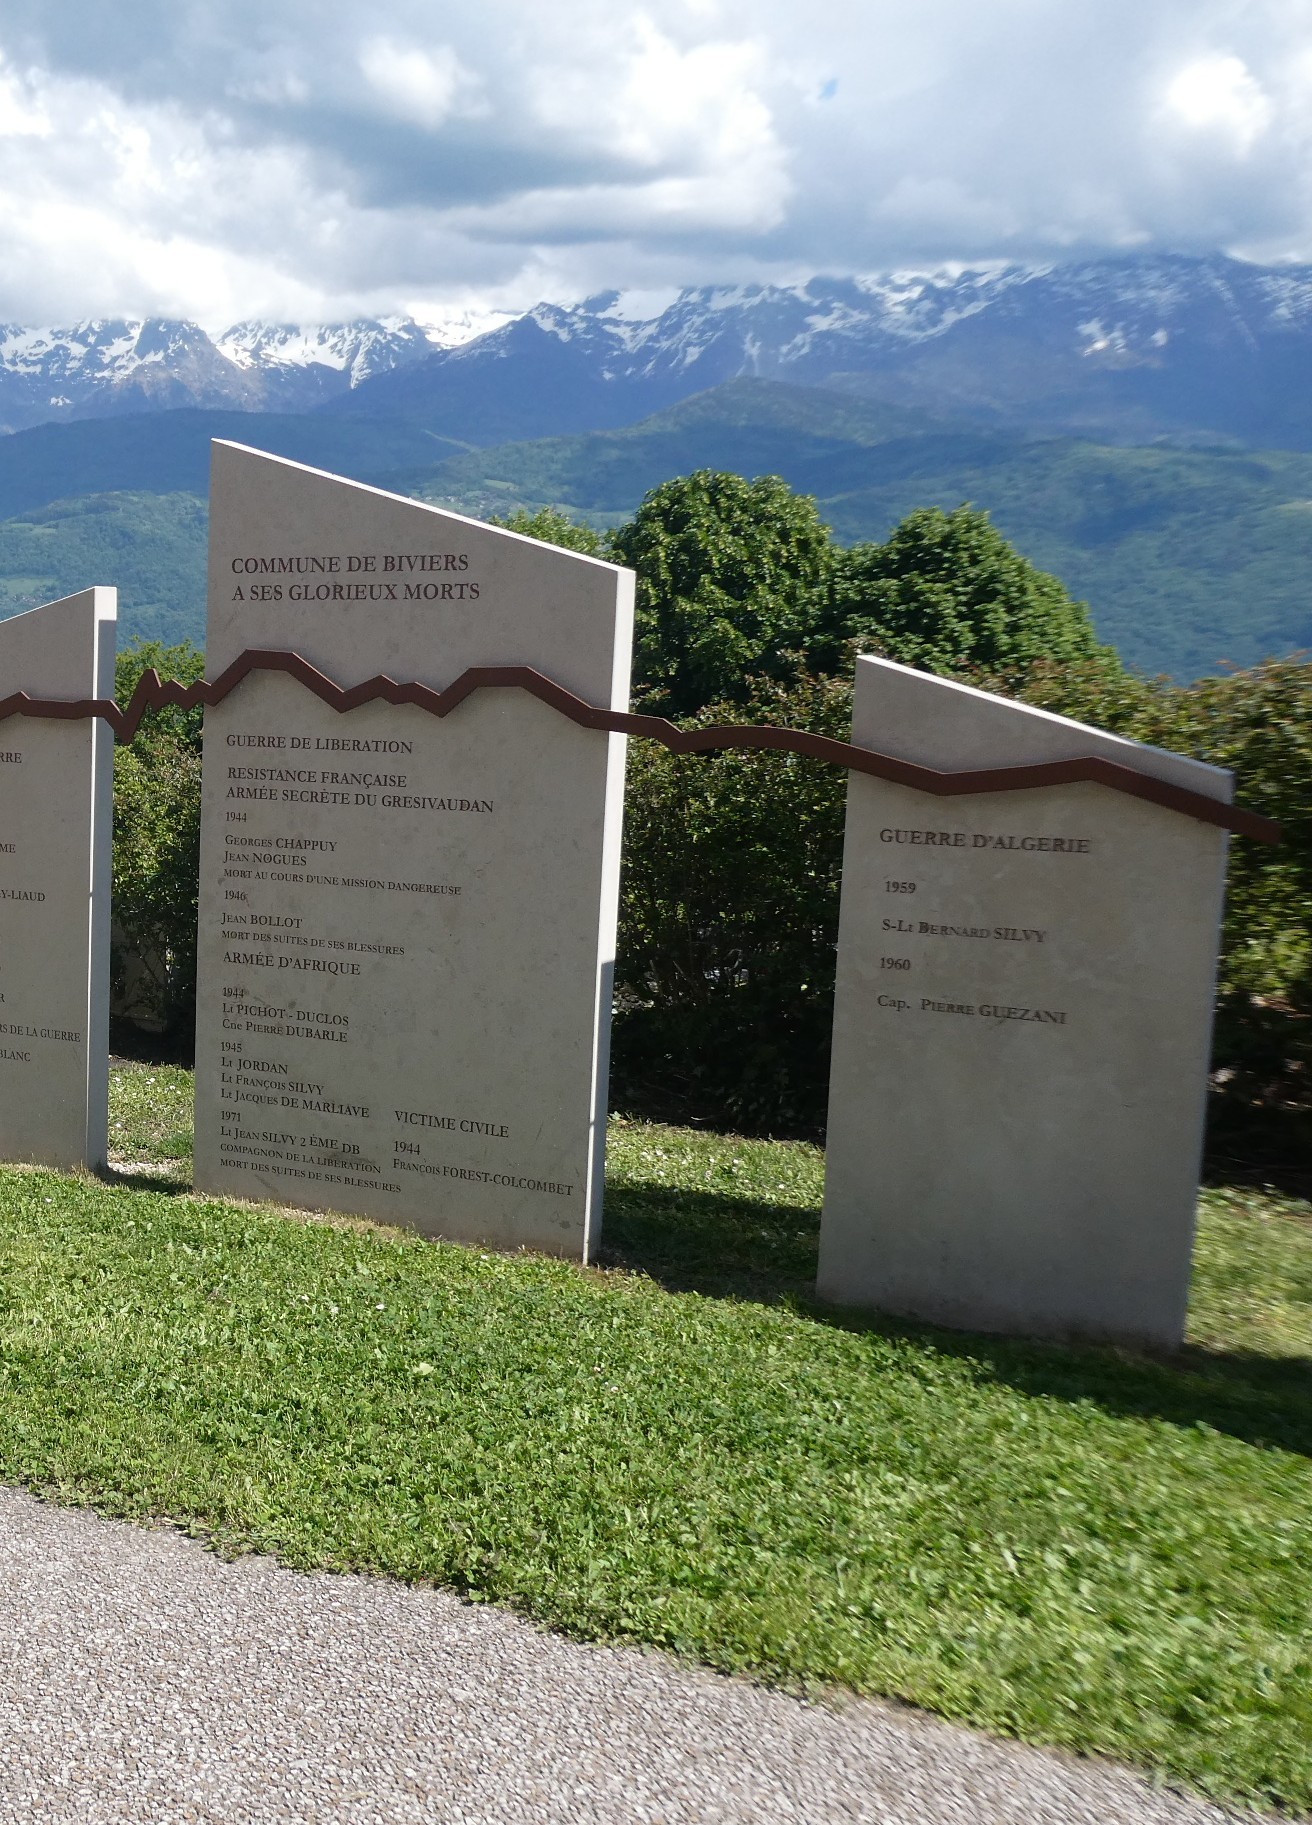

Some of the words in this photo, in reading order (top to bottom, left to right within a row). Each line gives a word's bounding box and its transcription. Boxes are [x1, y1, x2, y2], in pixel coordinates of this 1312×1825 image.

[232, 557, 340, 574] COMMUNE
[346, 556, 376, 572] DE
[382, 554, 469, 572] BIVIERS
[232, 586, 244, 601] A
[250, 585, 283, 601] SES
[288, 583, 398, 601] GLORIEUX
[404, 583, 480, 600] MORTS
[226, 734, 286, 749] GUERRE
[290, 737, 311, 750] DE
[315, 738, 414, 754] LIBERATION
[228, 767, 317, 783] RESISTANCE
[321, 772, 407, 789] FRANÇAISE
[226, 785, 278, 800] ARMÉE
[355, 793, 377, 806] DU
[382, 795, 494, 813] GRESIVAUDAN
[225, 811, 247, 823] 1944
[276, 838, 338, 852] CHAPPUY
[879, 828, 966, 848] GUERRE
[252, 852, 307, 866] NOGUES
[224, 869, 252, 878] MORT
[254, 871, 268, 880] AU
[270, 872, 304, 882] COURS
[306, 874, 339, 886] D'UNE
[342, 877, 385, 889] MISSION
[388, 881, 462, 896] DANGEREUSE
[885, 880, 916, 894] 1959
[224, 890, 247, 901] 1946
[250, 915, 303, 928] BOLLOT
[222, 930, 250, 940] MORT
[253, 933, 271, 942] DES
[273, 935, 308, 945] SUITES
[310, 938, 325, 948] DE
[327, 940, 345, 950] SES
[347, 942, 405, 956] BLESSURES
[993, 927, 1047, 943] SILVY
[223, 951, 274, 967] ARMÉE
[279, 956, 361, 976] D'AFRIQUE
[880, 957, 911, 971] 1960
[223, 987, 244, 999] 1944
[222, 1003, 234, 1014] Lt
[237, 1004, 286, 1019] PICHOT
[296, 1010, 349, 1026] DUCLOS
[877, 994, 911, 1012] Cap.
[979, 1004, 1068, 1025] GUEZANI
[10, 1025, 24, 1036] DE
[26, 1027, 38, 1037] LA
[40, 1028, 81, 1042] GUERRE
[222, 1018, 243, 1030] Cne
[286, 1025, 348, 1042] DUBARLE
[221, 1041, 242, 1052] 1945
[221, 1057, 232, 1068] Lt
[237, 1059, 288, 1074] JORDAN
[221, 1073, 232, 1083] Lt
[288, 1081, 325, 1095] SILVY
[221, 1088, 232, 1099] Lt
[281, 1096, 299, 1108] DE
[302, 1099, 370, 1118] MARLIAVE
[221, 1110, 241, 1122] 1971
[395, 1110, 456, 1131] VICTIME
[460, 1119, 509, 1138] CIVILE
[220, 1126, 232, 1137] Lt
[262, 1131, 297, 1145] SILVY
[300, 1137, 307, 1147] 2
[342, 1143, 360, 1155] DB
[393, 1140, 420, 1156] 1944
[220, 1143, 283, 1159] COMPAGNON
[286, 1152, 300, 1162] DE
[302, 1154, 315, 1164] LA
[317, 1157, 381, 1174] LIBERATION
[220, 1158, 248, 1169] MORT
[251, 1162, 270, 1172] DES
[271, 1166, 306, 1178] SUITES
[308, 1171, 322, 1181] DE
[324, 1174, 342, 1184] SES
[344, 1177, 401, 1193] BLESSURES
[443, 1166, 574, 1196] FOREST-COLOMBET
